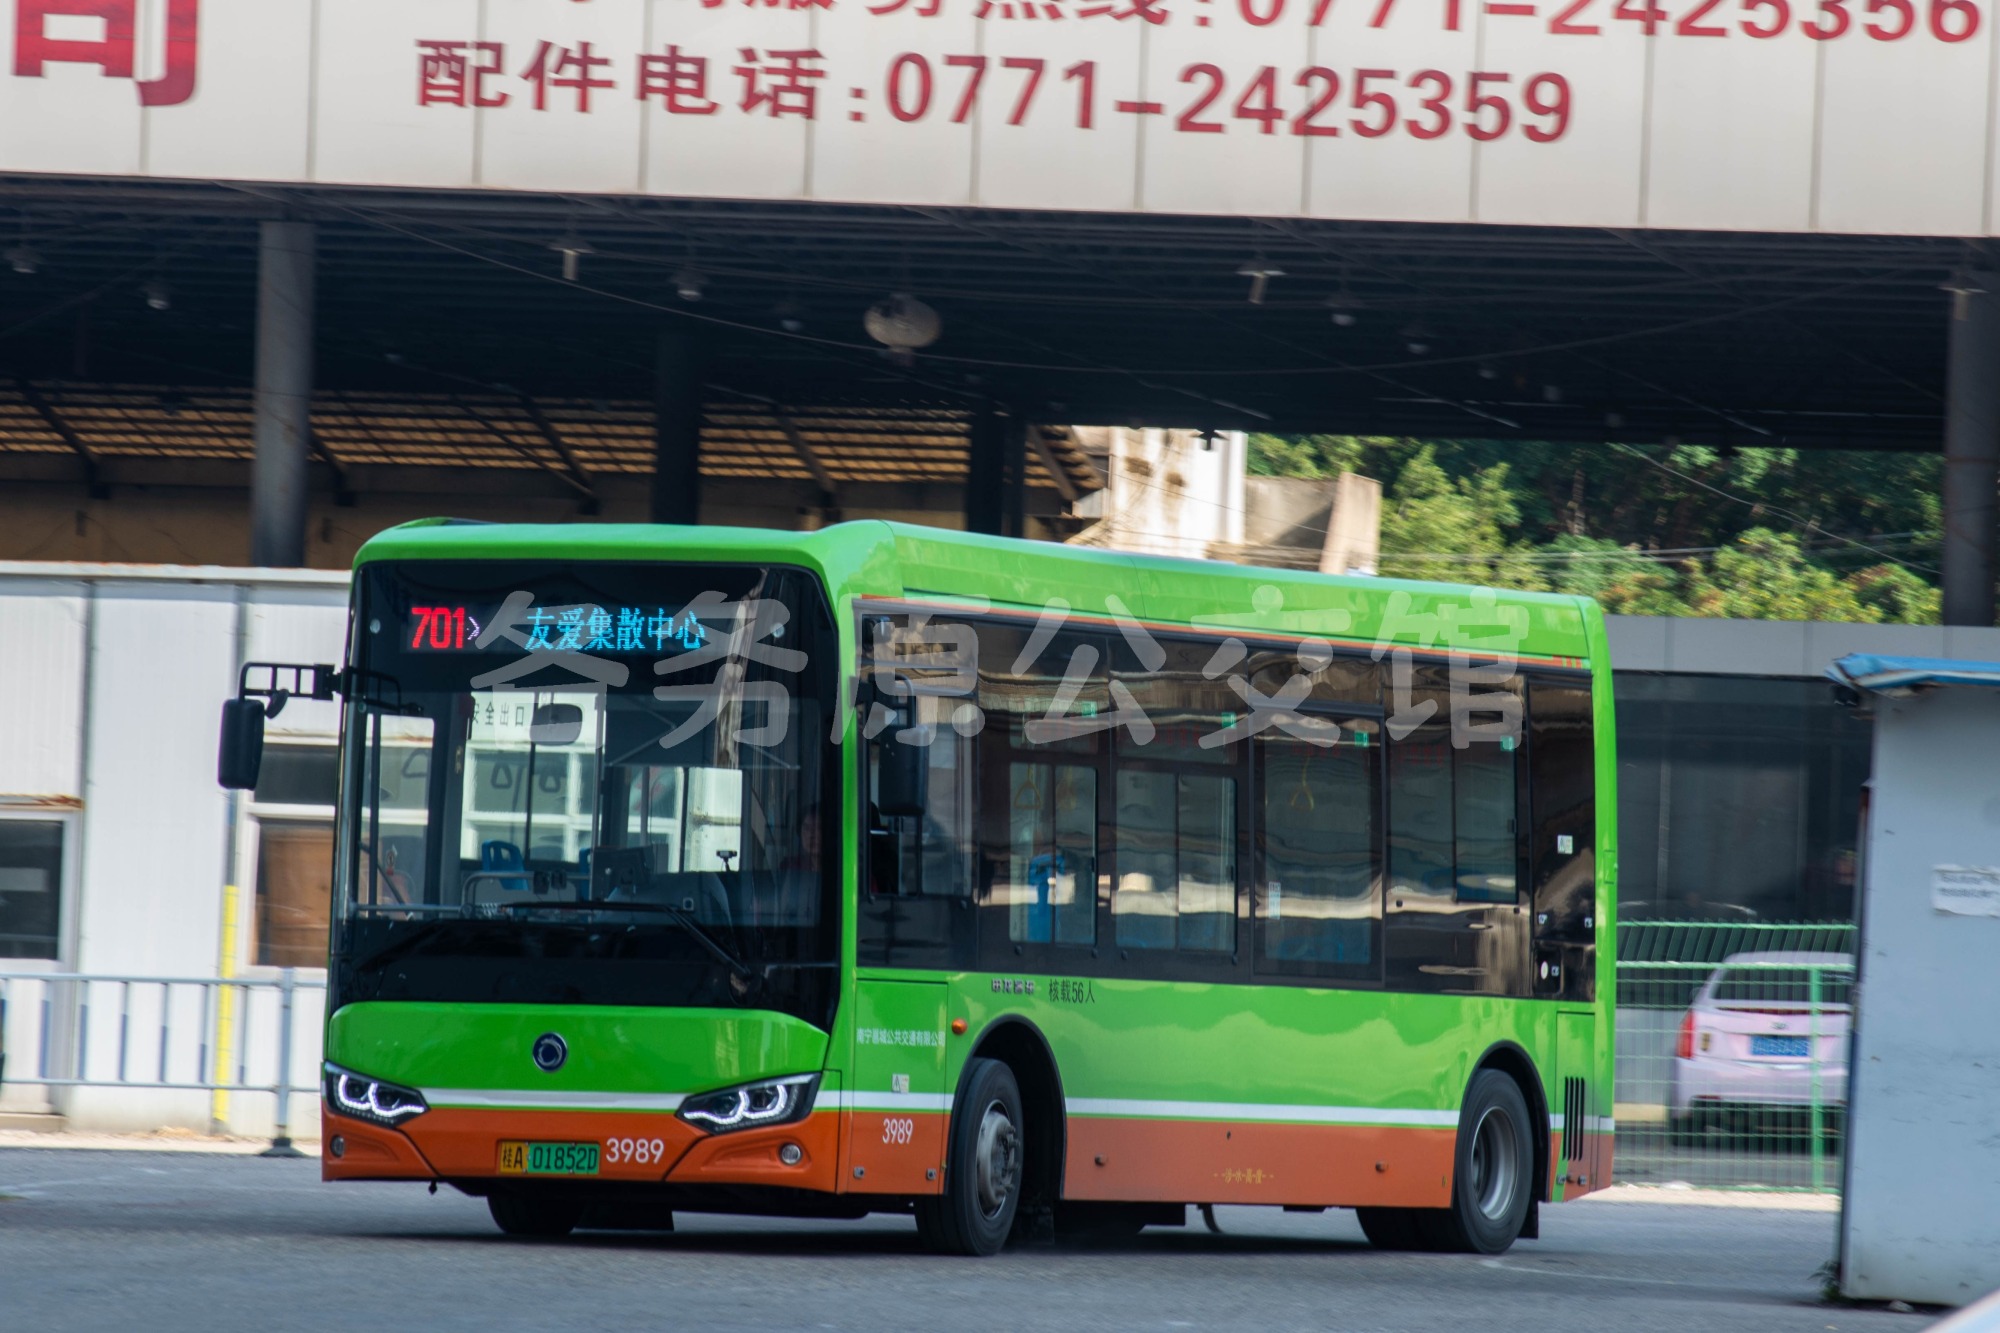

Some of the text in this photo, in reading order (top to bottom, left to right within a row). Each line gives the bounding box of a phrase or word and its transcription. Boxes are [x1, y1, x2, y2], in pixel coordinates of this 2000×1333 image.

[411, 606, 706, 652] 701 友爱集散中心
[1048, 979, 1095, 1003] 核载56人
[882, 1118, 913, 1144] 3989
[605, 1137, 665, 1165] 3989
